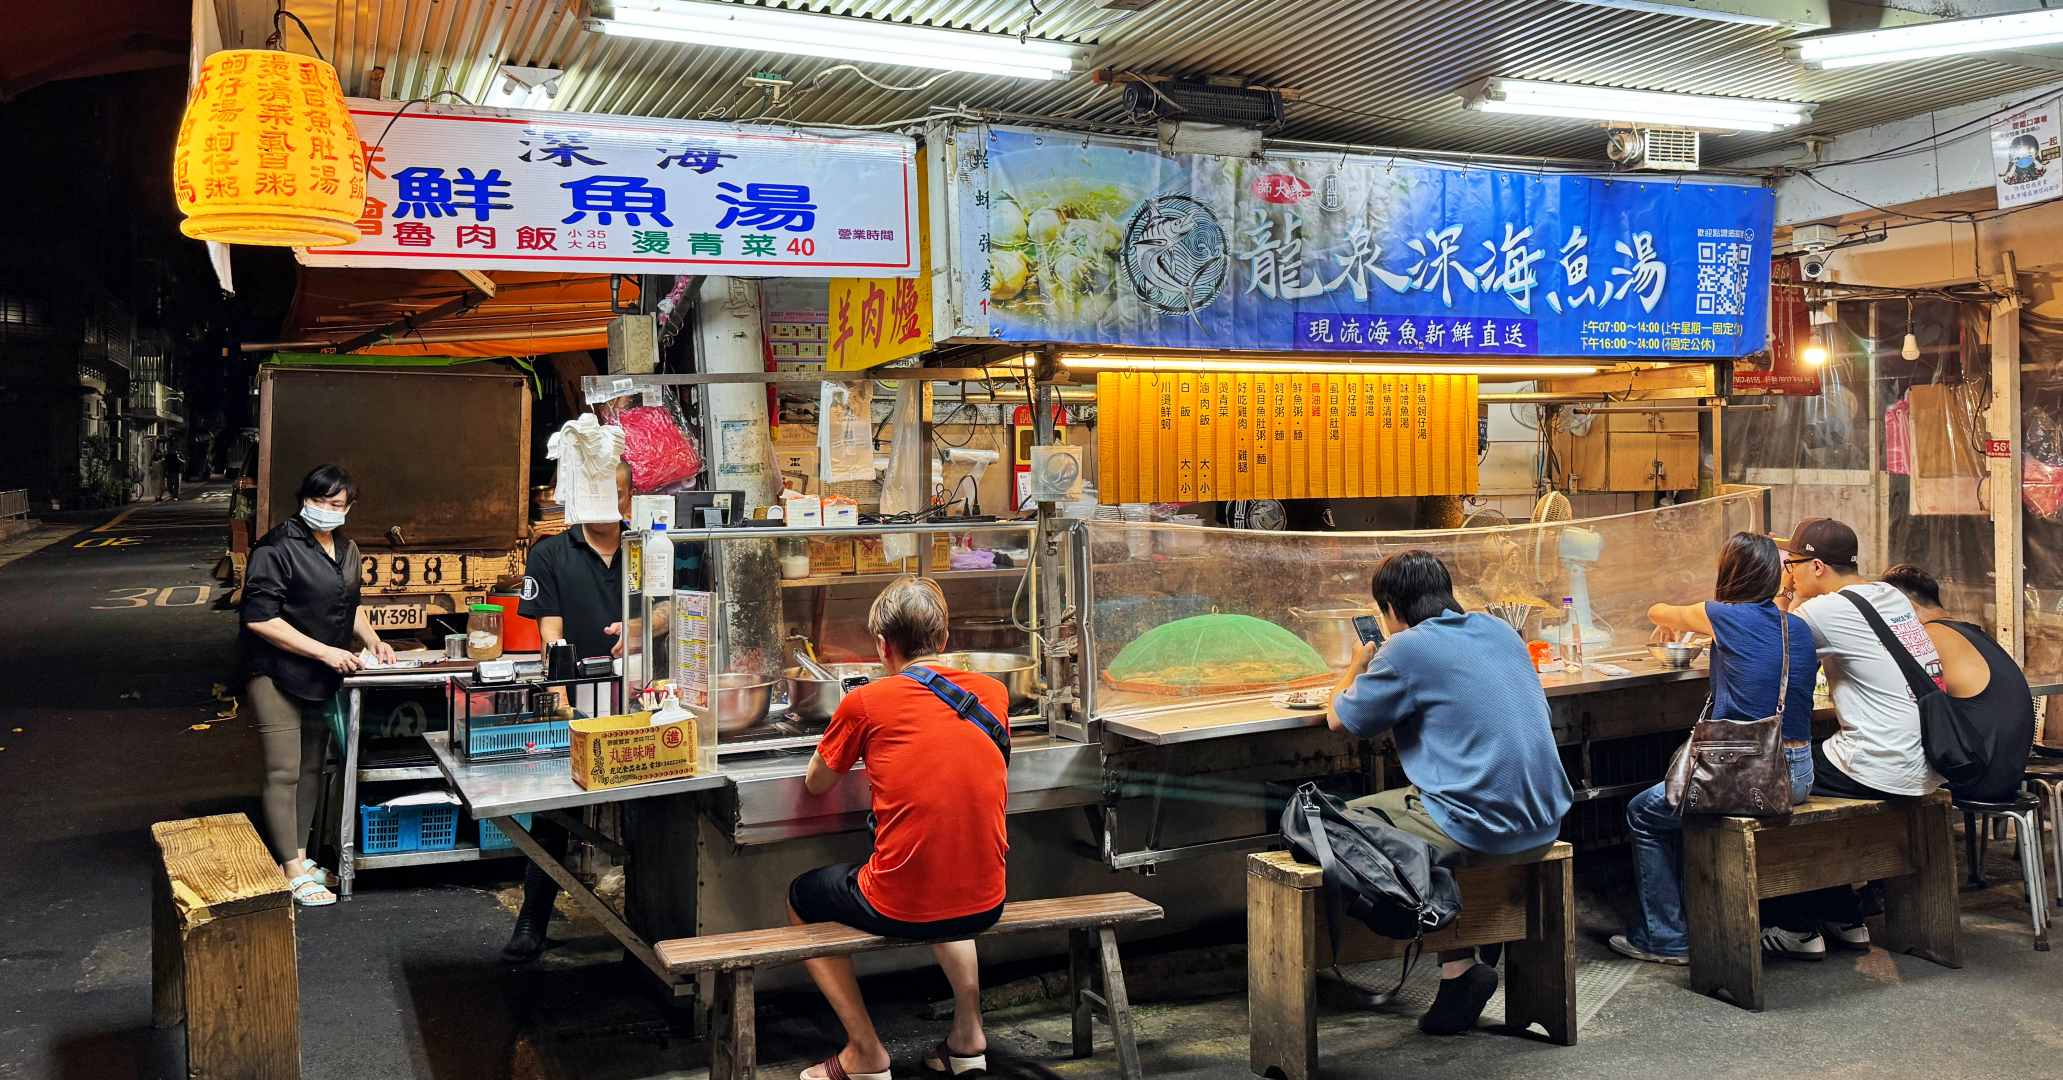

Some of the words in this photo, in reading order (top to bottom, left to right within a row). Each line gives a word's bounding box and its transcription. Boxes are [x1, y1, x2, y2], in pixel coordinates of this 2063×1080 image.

[518, 127, 738, 175] 深海
[391, 166, 818, 233] 鮮魚湯
[567, 230, 583, 238] 小
[586, 230, 606, 239] 35
[567, 240, 583, 249] 大
[586, 240, 607, 250] 45
[786, 238, 815, 257] 40
[838, 228, 894, 242] 營業時間
[1237, 209, 1668, 314] 龍泉深海魚湯
[833, 278, 922, 369] 羊肉爐
[1309, 317, 1527, 349] 現流海魚新鮮直送
[361, 555, 467, 586] 3981
[89, 585, 212, 610] 30
